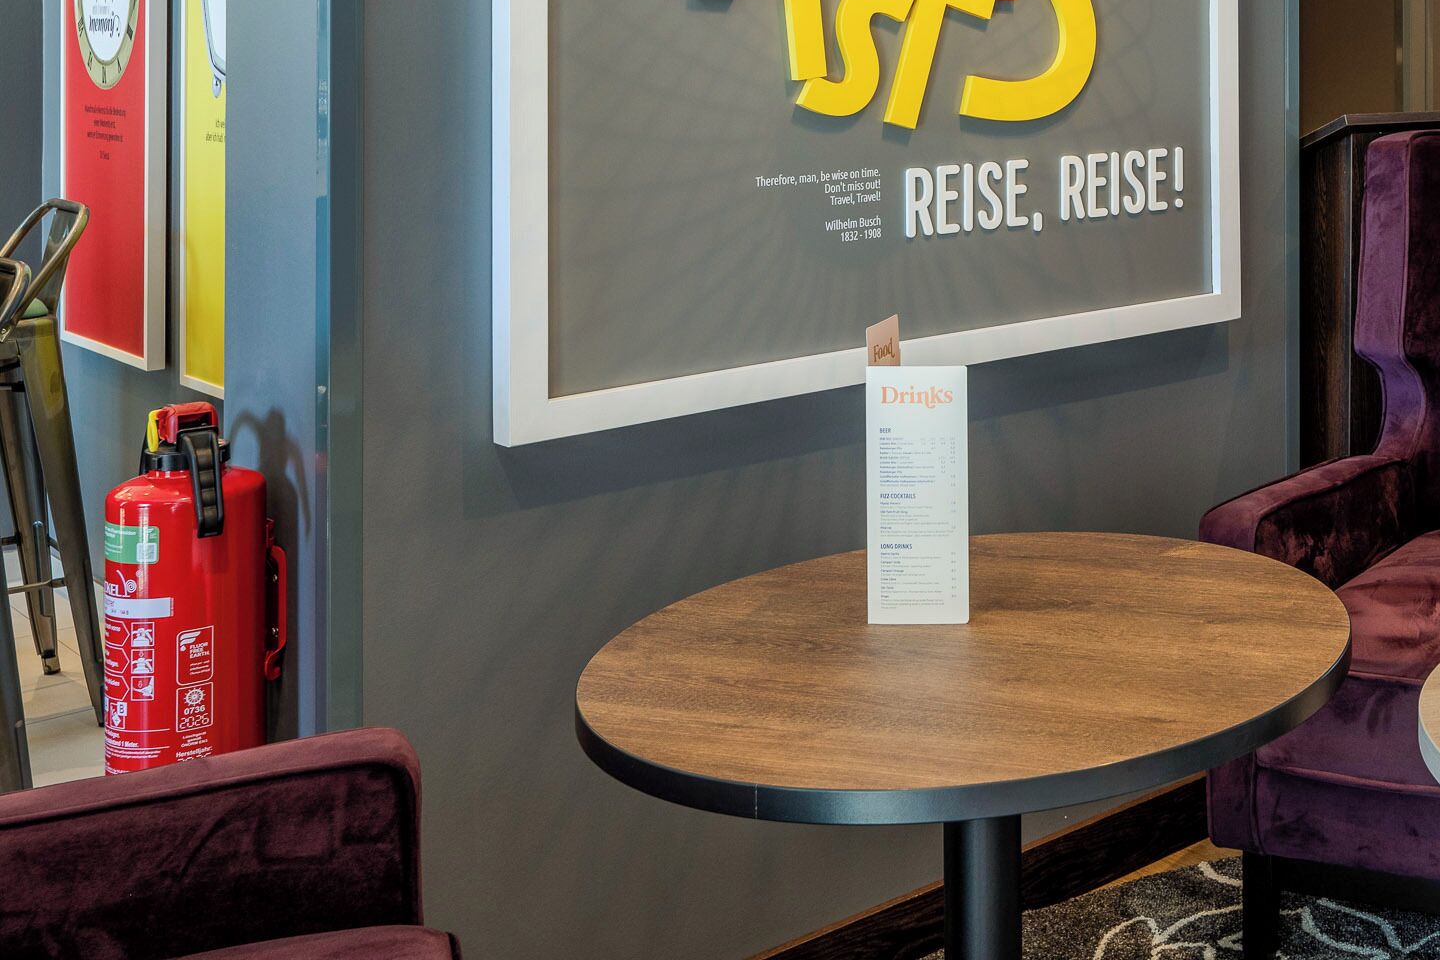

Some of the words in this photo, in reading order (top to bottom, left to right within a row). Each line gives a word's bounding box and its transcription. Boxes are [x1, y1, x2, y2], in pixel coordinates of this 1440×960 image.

[755, 173, 798, 188] Therefore,
[799, 172, 819, 184] man,
[820, 170, 831, 182] be
[831, 169, 848, 181] wise
[849, 169, 860, 179] on
[861, 167, 881, 178] time.
[824, 182, 847, 194] Don't
[847, 180, 865, 192] miss
[865, 178, 881, 191] out!
[830, 194, 855, 206] Travel,
[856, 190, 881, 203] Travel!
[905, 158, 1044, 239] REISE,
[1060, 146, 1184, 222] REISE!
[825, 217, 858, 232] Wilhelm
[859, 215, 882, 228] Busch
[840, 230, 859, 242] 1832
[864, 227, 882, 239] 1908
[873, 337, 896, 363] Food
[880, 385, 954, 409] Drinks
